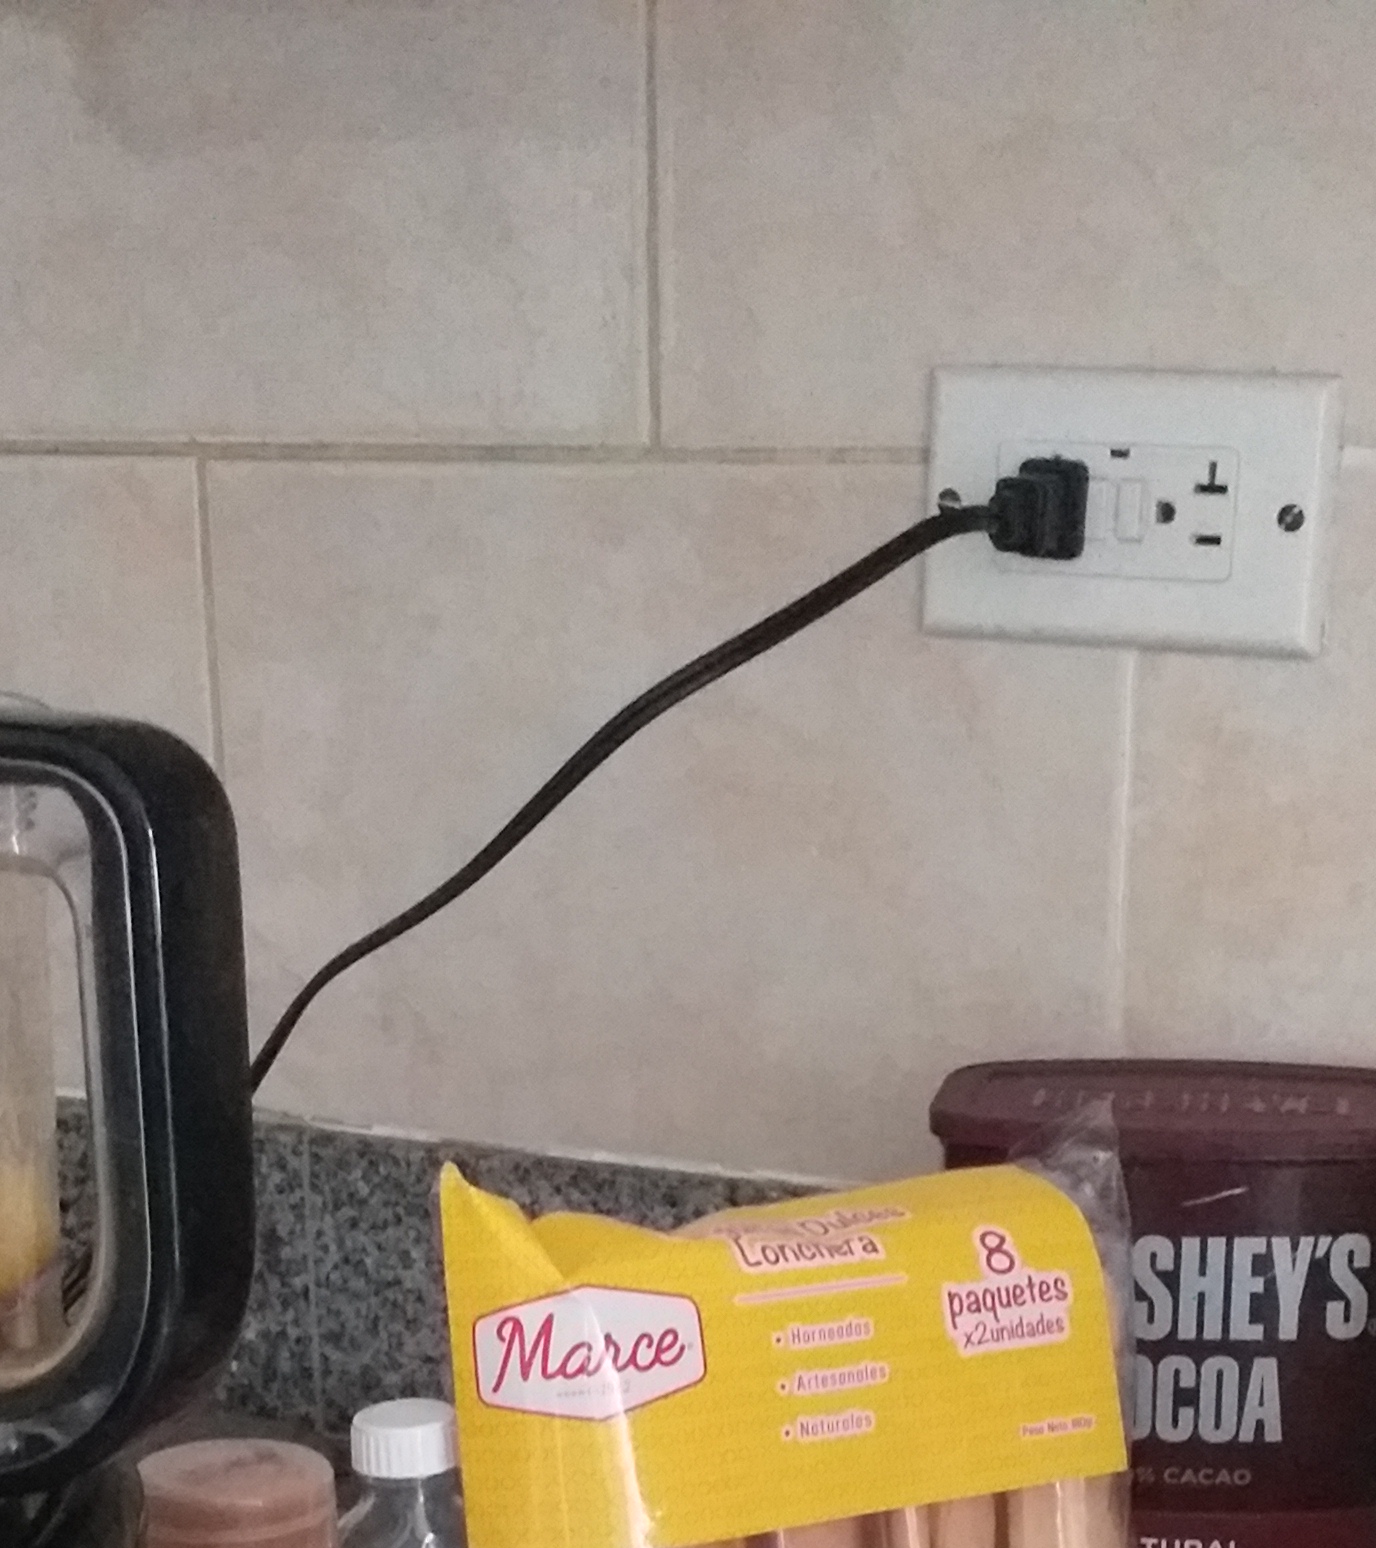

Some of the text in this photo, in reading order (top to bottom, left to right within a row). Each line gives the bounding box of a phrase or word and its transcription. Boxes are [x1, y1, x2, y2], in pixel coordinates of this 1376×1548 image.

[733, 1234, 880, 1268] Lonchera
[979, 1229, 1016, 1275] 8
[947, 1274, 1069, 1331] paquetes
[1131, 1232, 1372, 1342] SHEY'S
[491, 1311, 686, 1394] Marce
[790, 1320, 872, 1345] Horneados
[797, 1364, 887, 1392] Artesanales
[1130, 1354, 1283, 1444] OCOA
[799, 1412, 873, 1438] Naturales
[1163, 1467, 1252, 1486] CACAO
